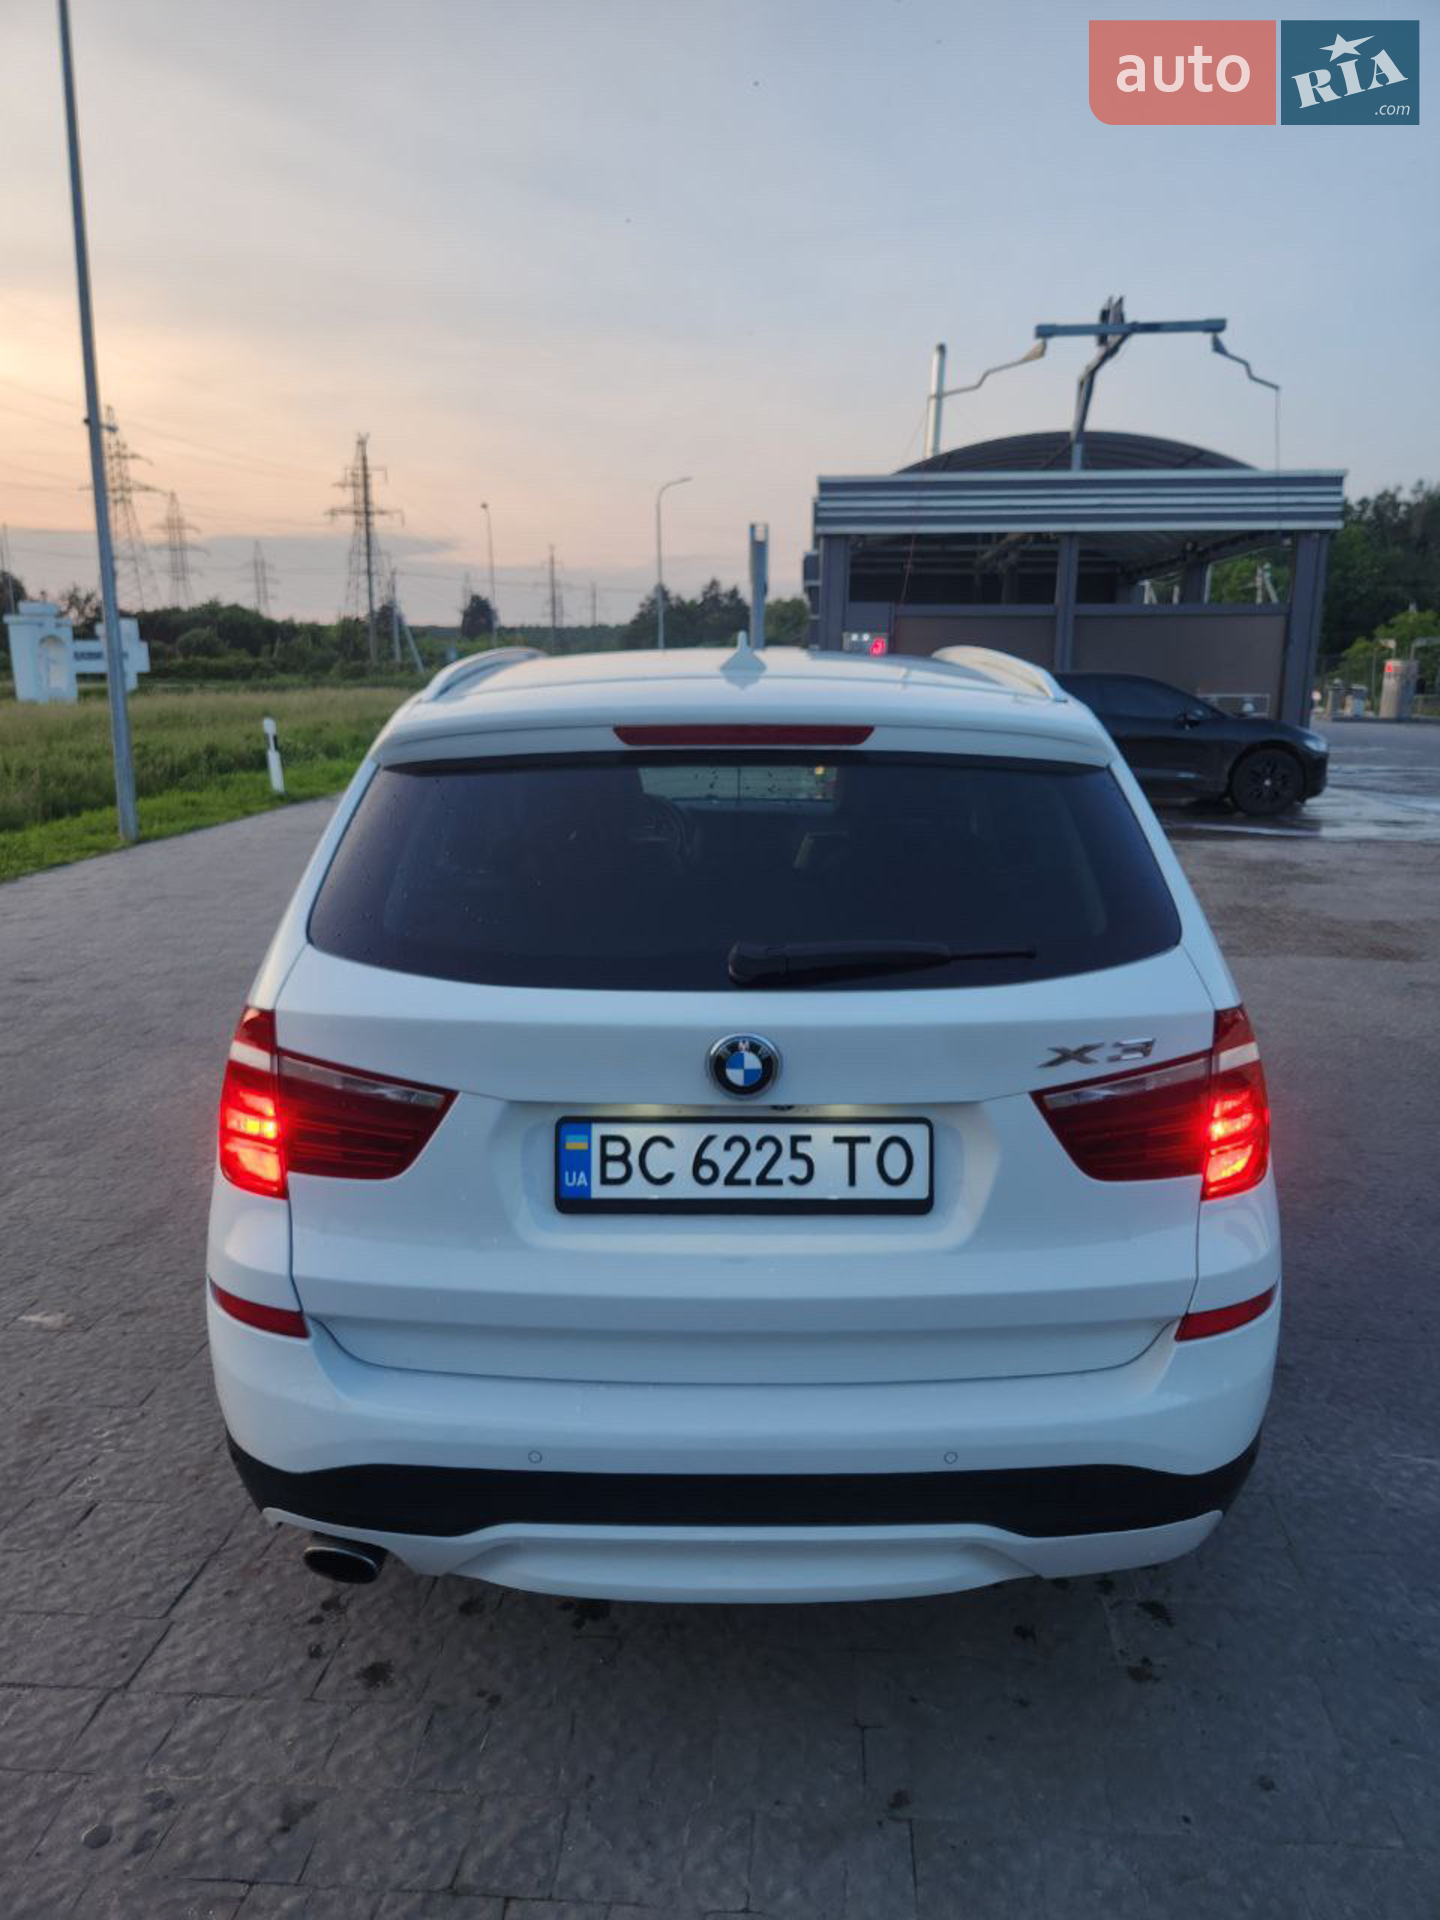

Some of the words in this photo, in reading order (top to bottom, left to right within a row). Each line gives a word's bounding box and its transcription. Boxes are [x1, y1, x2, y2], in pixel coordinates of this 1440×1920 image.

[1036, 1037, 1156, 1068] X3
[600, 1135, 674, 1186] BC
[692, 1135, 814, 1186] 6225
[833, 1136, 914, 1187] TO
[565, 1171, 588, 1187] UA
